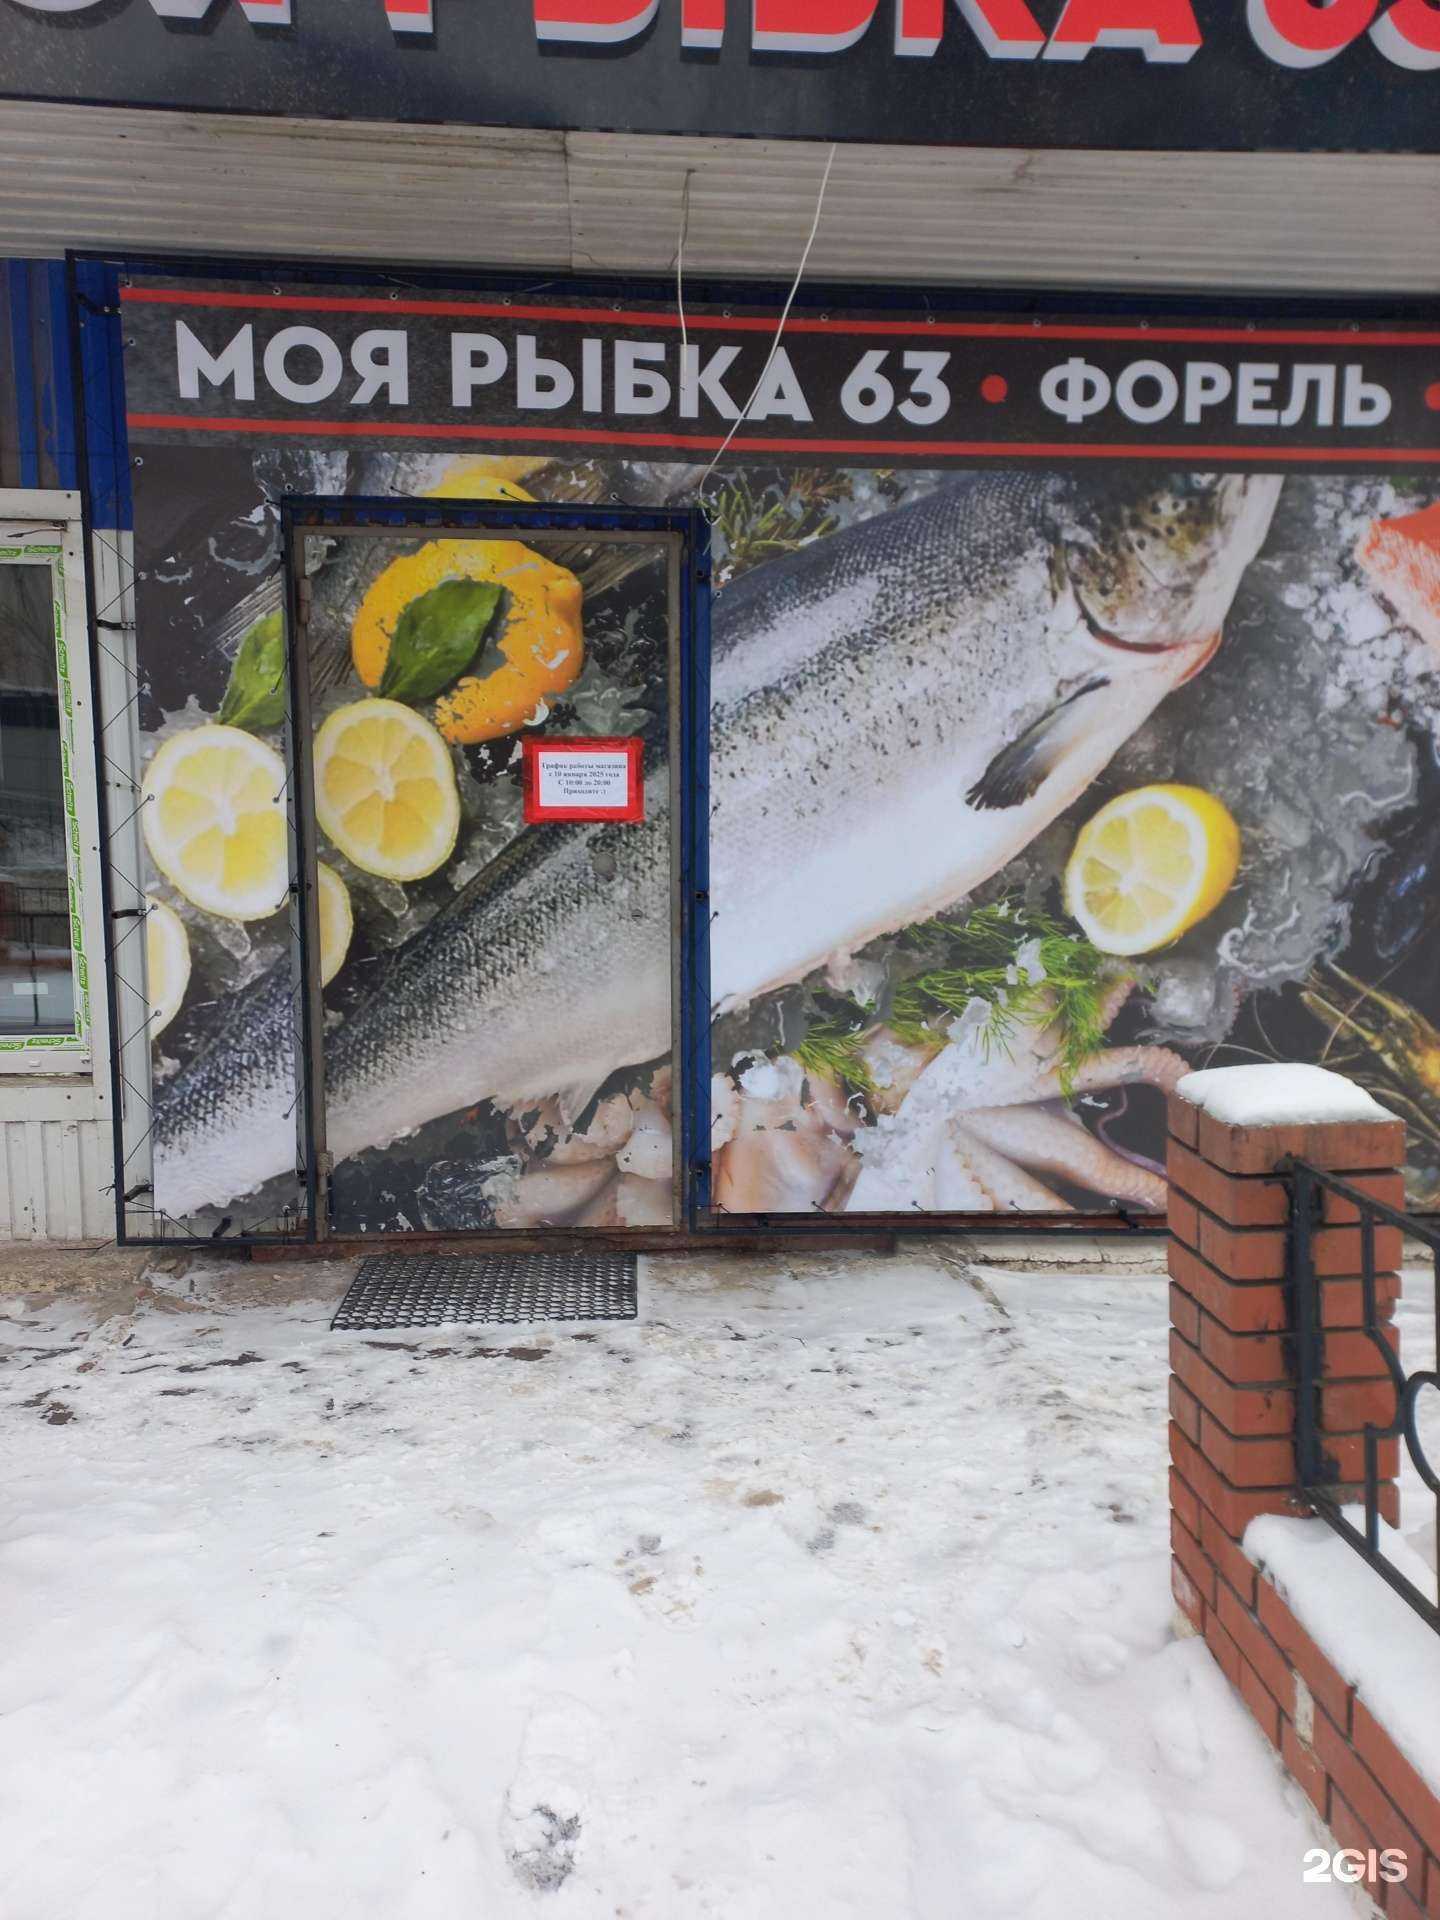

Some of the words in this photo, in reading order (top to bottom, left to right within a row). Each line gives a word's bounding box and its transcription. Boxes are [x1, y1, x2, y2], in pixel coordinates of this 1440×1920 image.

[175, 319, 409, 405] МОЯ
[451, 331, 813, 422] РЫБКА
[840, 349, 952, 425] 63
[1039, 356, 1392, 427] ФОРЕЛЬ
